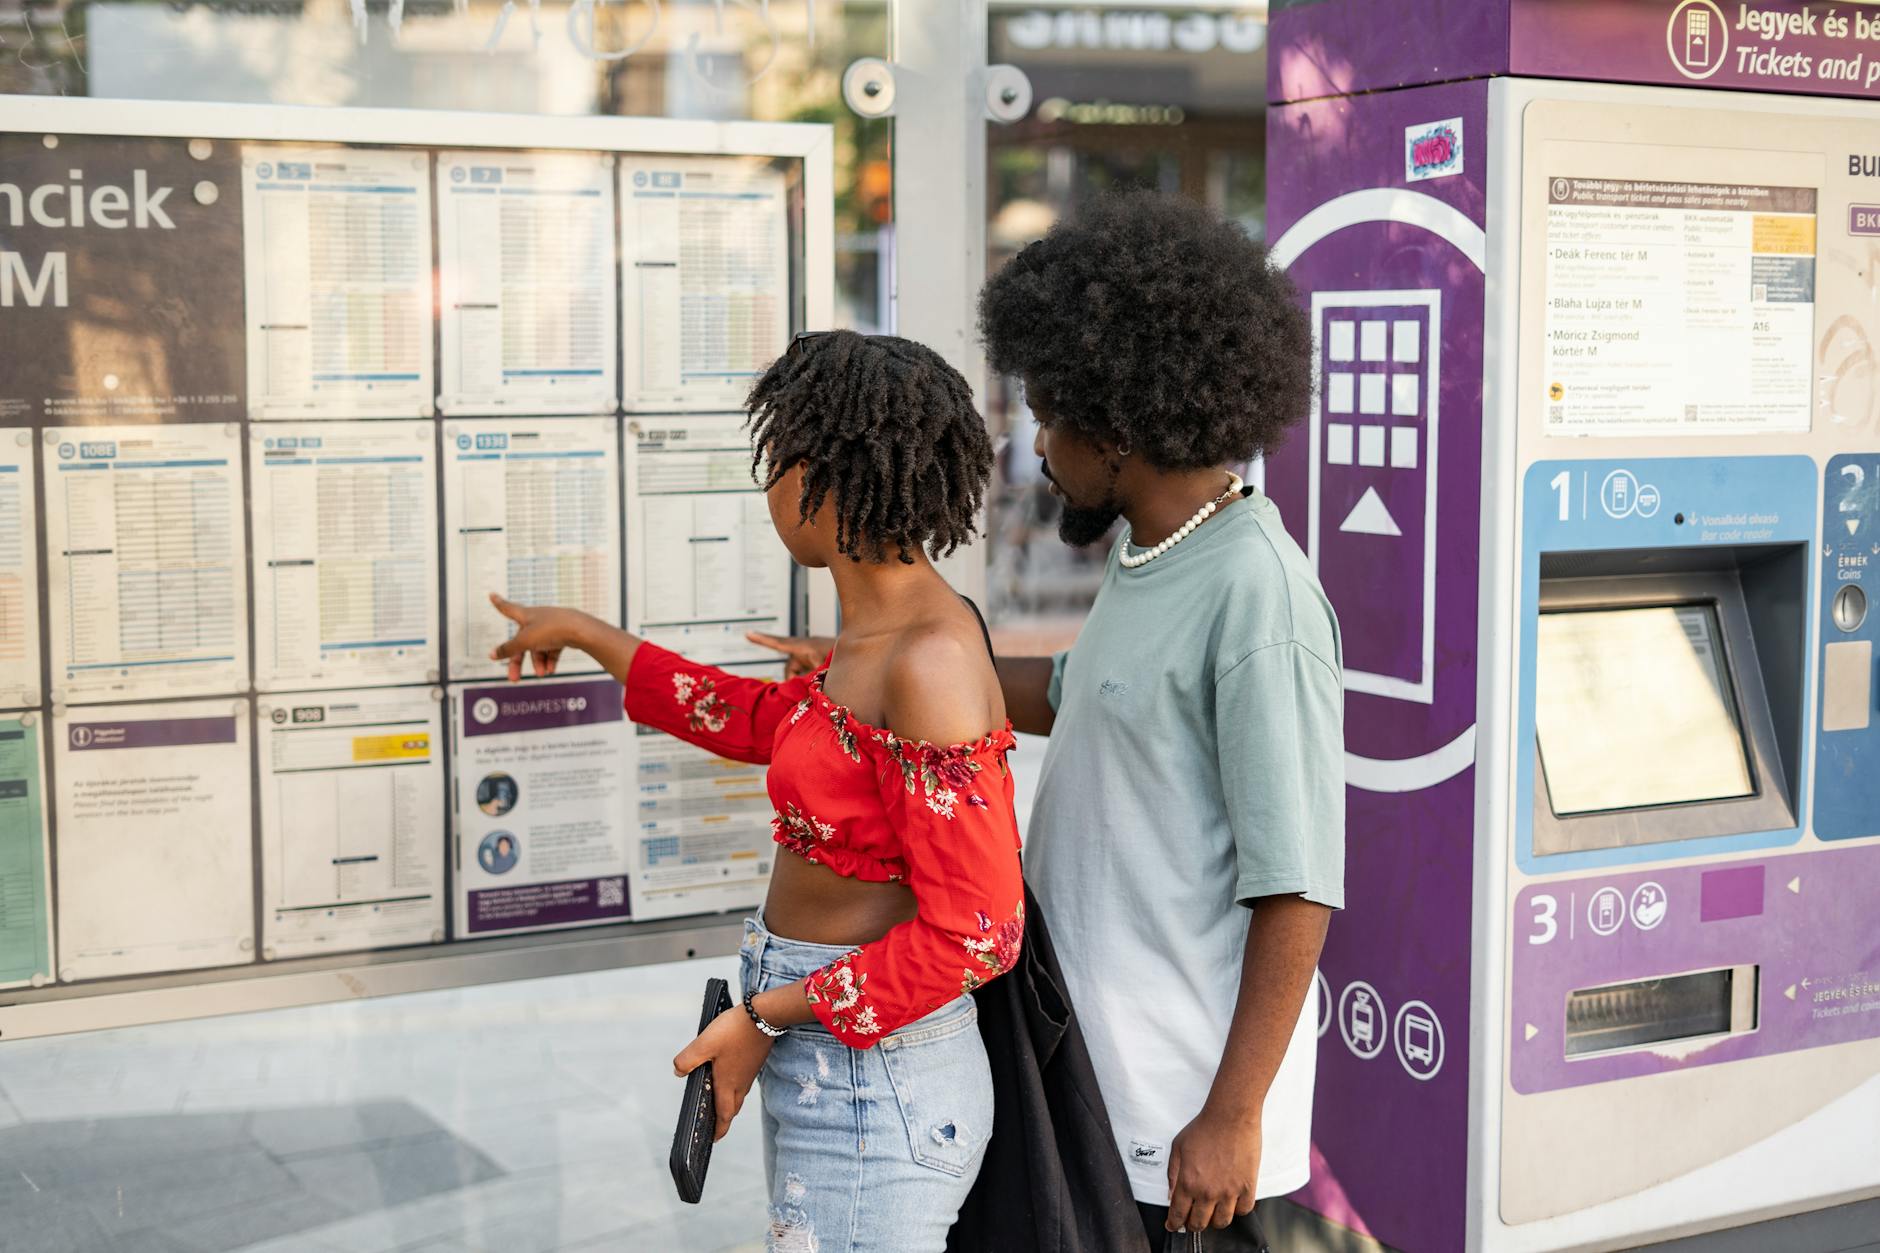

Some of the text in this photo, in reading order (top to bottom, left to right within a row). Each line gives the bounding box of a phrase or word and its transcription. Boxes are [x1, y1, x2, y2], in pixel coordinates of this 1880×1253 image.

[1736, 4, 1817, 41] Jegyek
[1823, 9, 1848, 38] és
[1736, 46, 1812, 78] Tickets
[1818, 53, 1863, 81] and
[1849, 155, 1880, 176] BU
[0, 169, 177, 229] nciek
[1572, 192, 1595, 201] Public
[1596, 193, 1629, 203] transport
[1630, 194, 1650, 203] ticket
[1857, 213, 1880, 228] BK
[1555, 248, 1648, 260] Deák Ferenc tér M
[0, 252, 68, 307] M
[1554, 298, 1643, 312] Blaha Lujza tér M
[1591, 331, 1640, 343] Zsigmond
[1587, 346, 1598, 357] M
[1551, 471, 1570, 521] 1
[1839, 464, 1865, 512] 2
[1838, 553, 1868, 568] ÉRMÉK
[1837, 569, 1862, 580] Coins
[1529, 894, 1557, 945] 3
